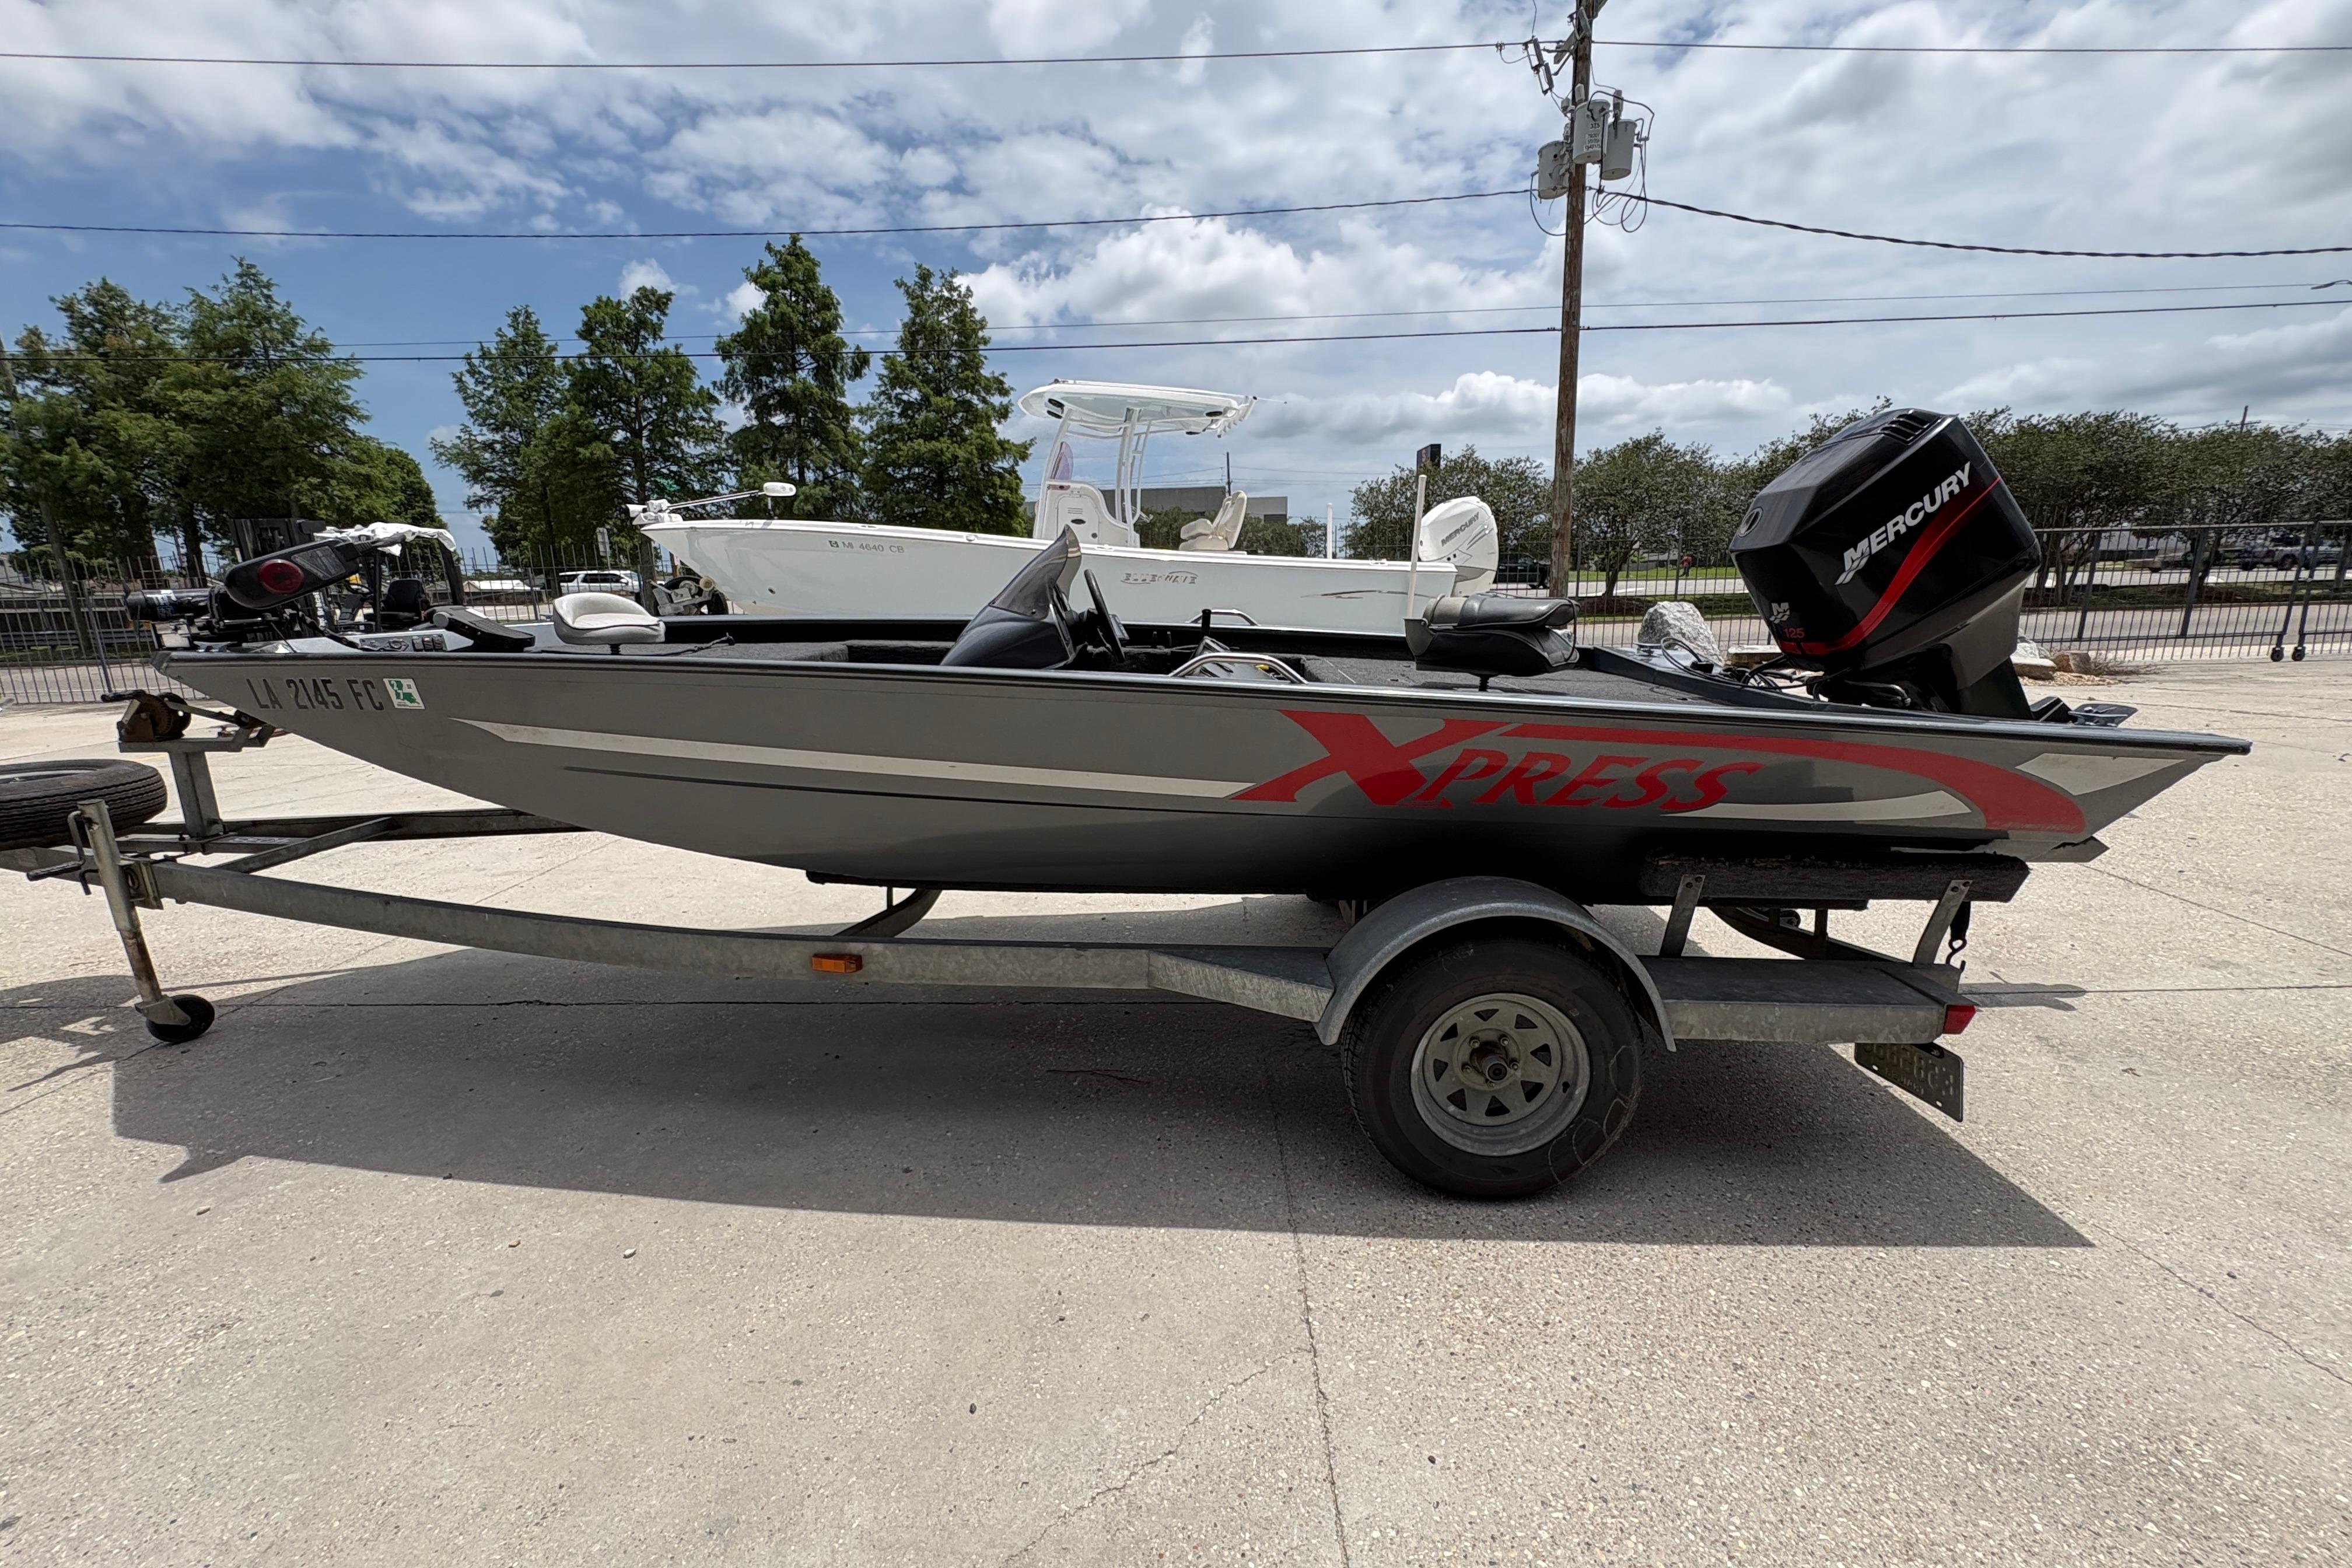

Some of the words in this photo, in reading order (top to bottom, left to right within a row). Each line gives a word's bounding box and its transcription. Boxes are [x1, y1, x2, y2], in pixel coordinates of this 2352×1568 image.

[1441, 511, 1479, 547] MERCURY
[1838, 461, 1971, 583] MERCURY
[841, 541, 854, 550] MI
[859, 542, 884, 552] 4640
[889, 545, 905, 553] CB
[1783, 628, 1805, 638] 125
[246, 678, 283, 709] LA
[285, 678, 345, 710] 2145
[346, 678, 385, 710] FC
